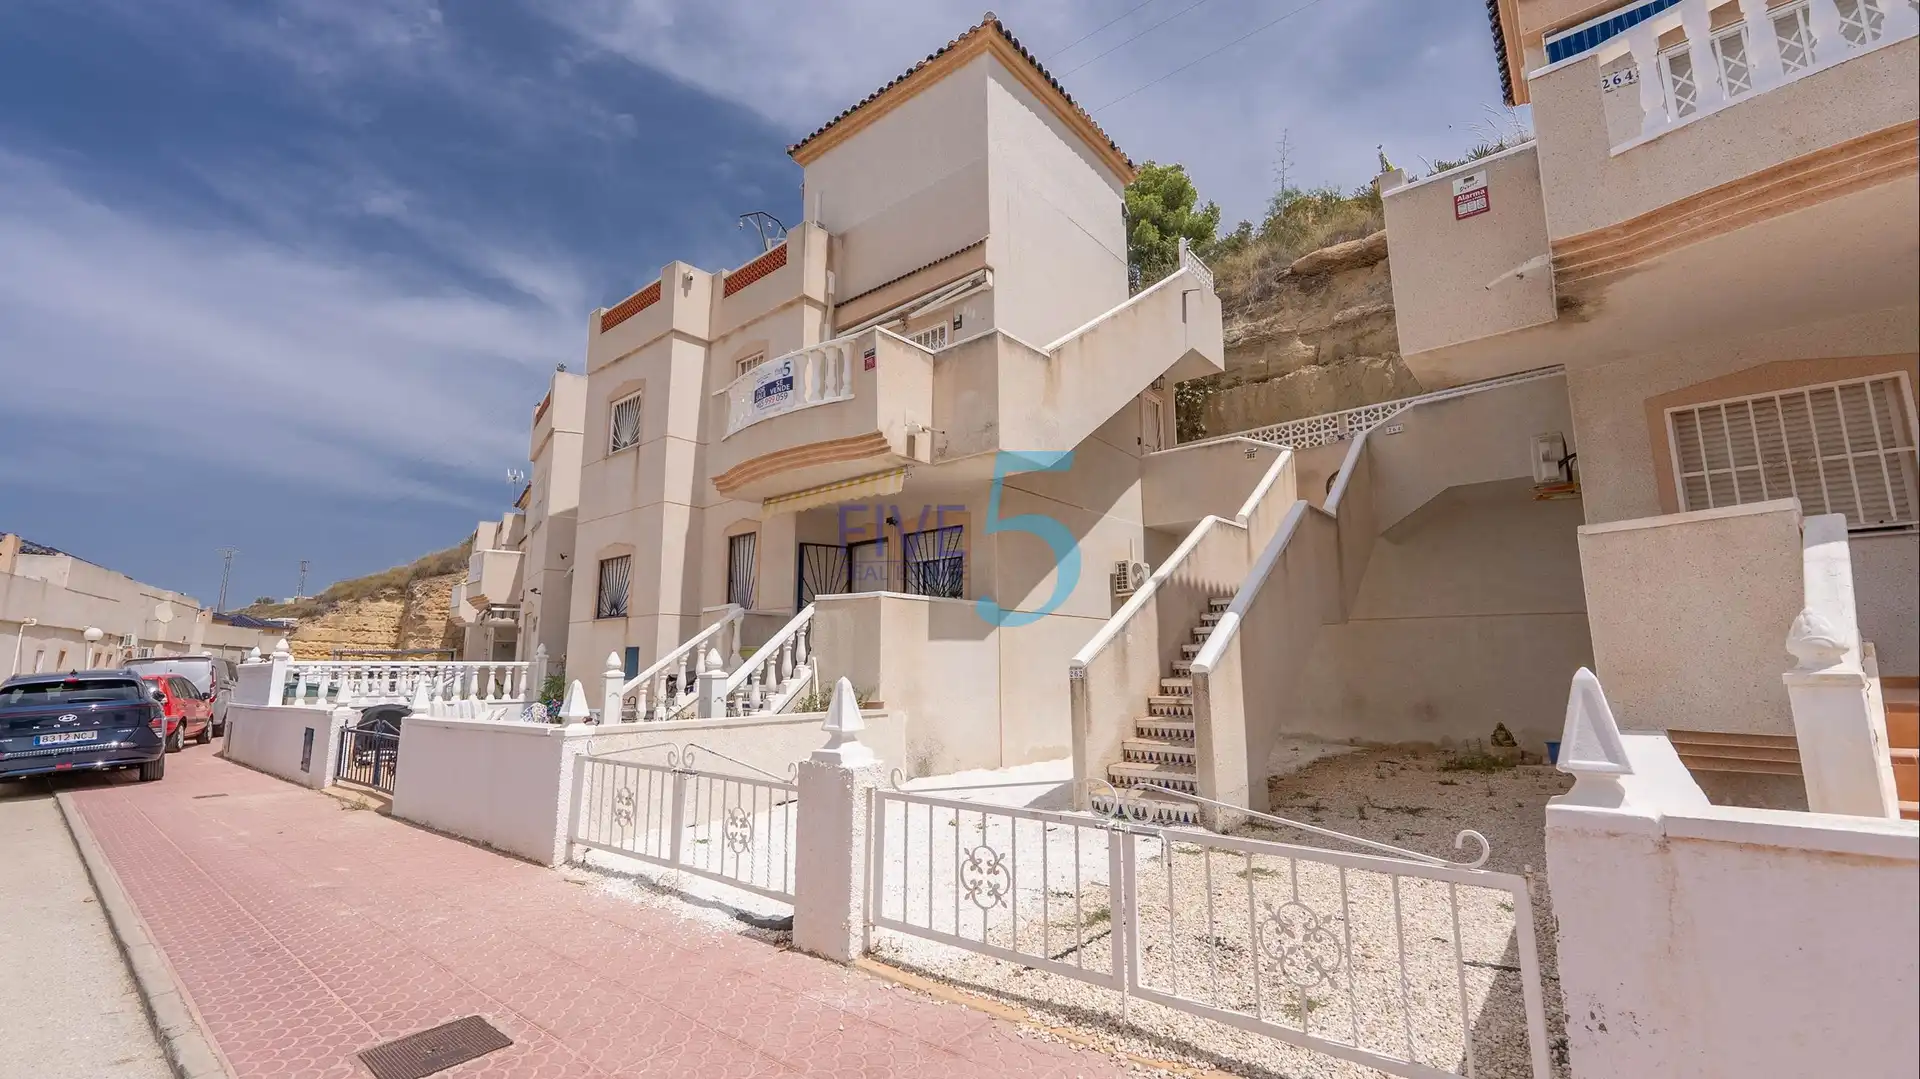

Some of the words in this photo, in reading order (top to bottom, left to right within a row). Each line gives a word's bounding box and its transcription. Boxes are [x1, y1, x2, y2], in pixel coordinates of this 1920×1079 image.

[1602, 70, 1633, 90] 264
[1457, 189, 1486, 202] Alarma
[770, 384, 791, 395] VENDE
[776, 391, 789, 402] 059
[41, 733, 71, 744] 8312
[73, 730, 95, 740] NCJ
